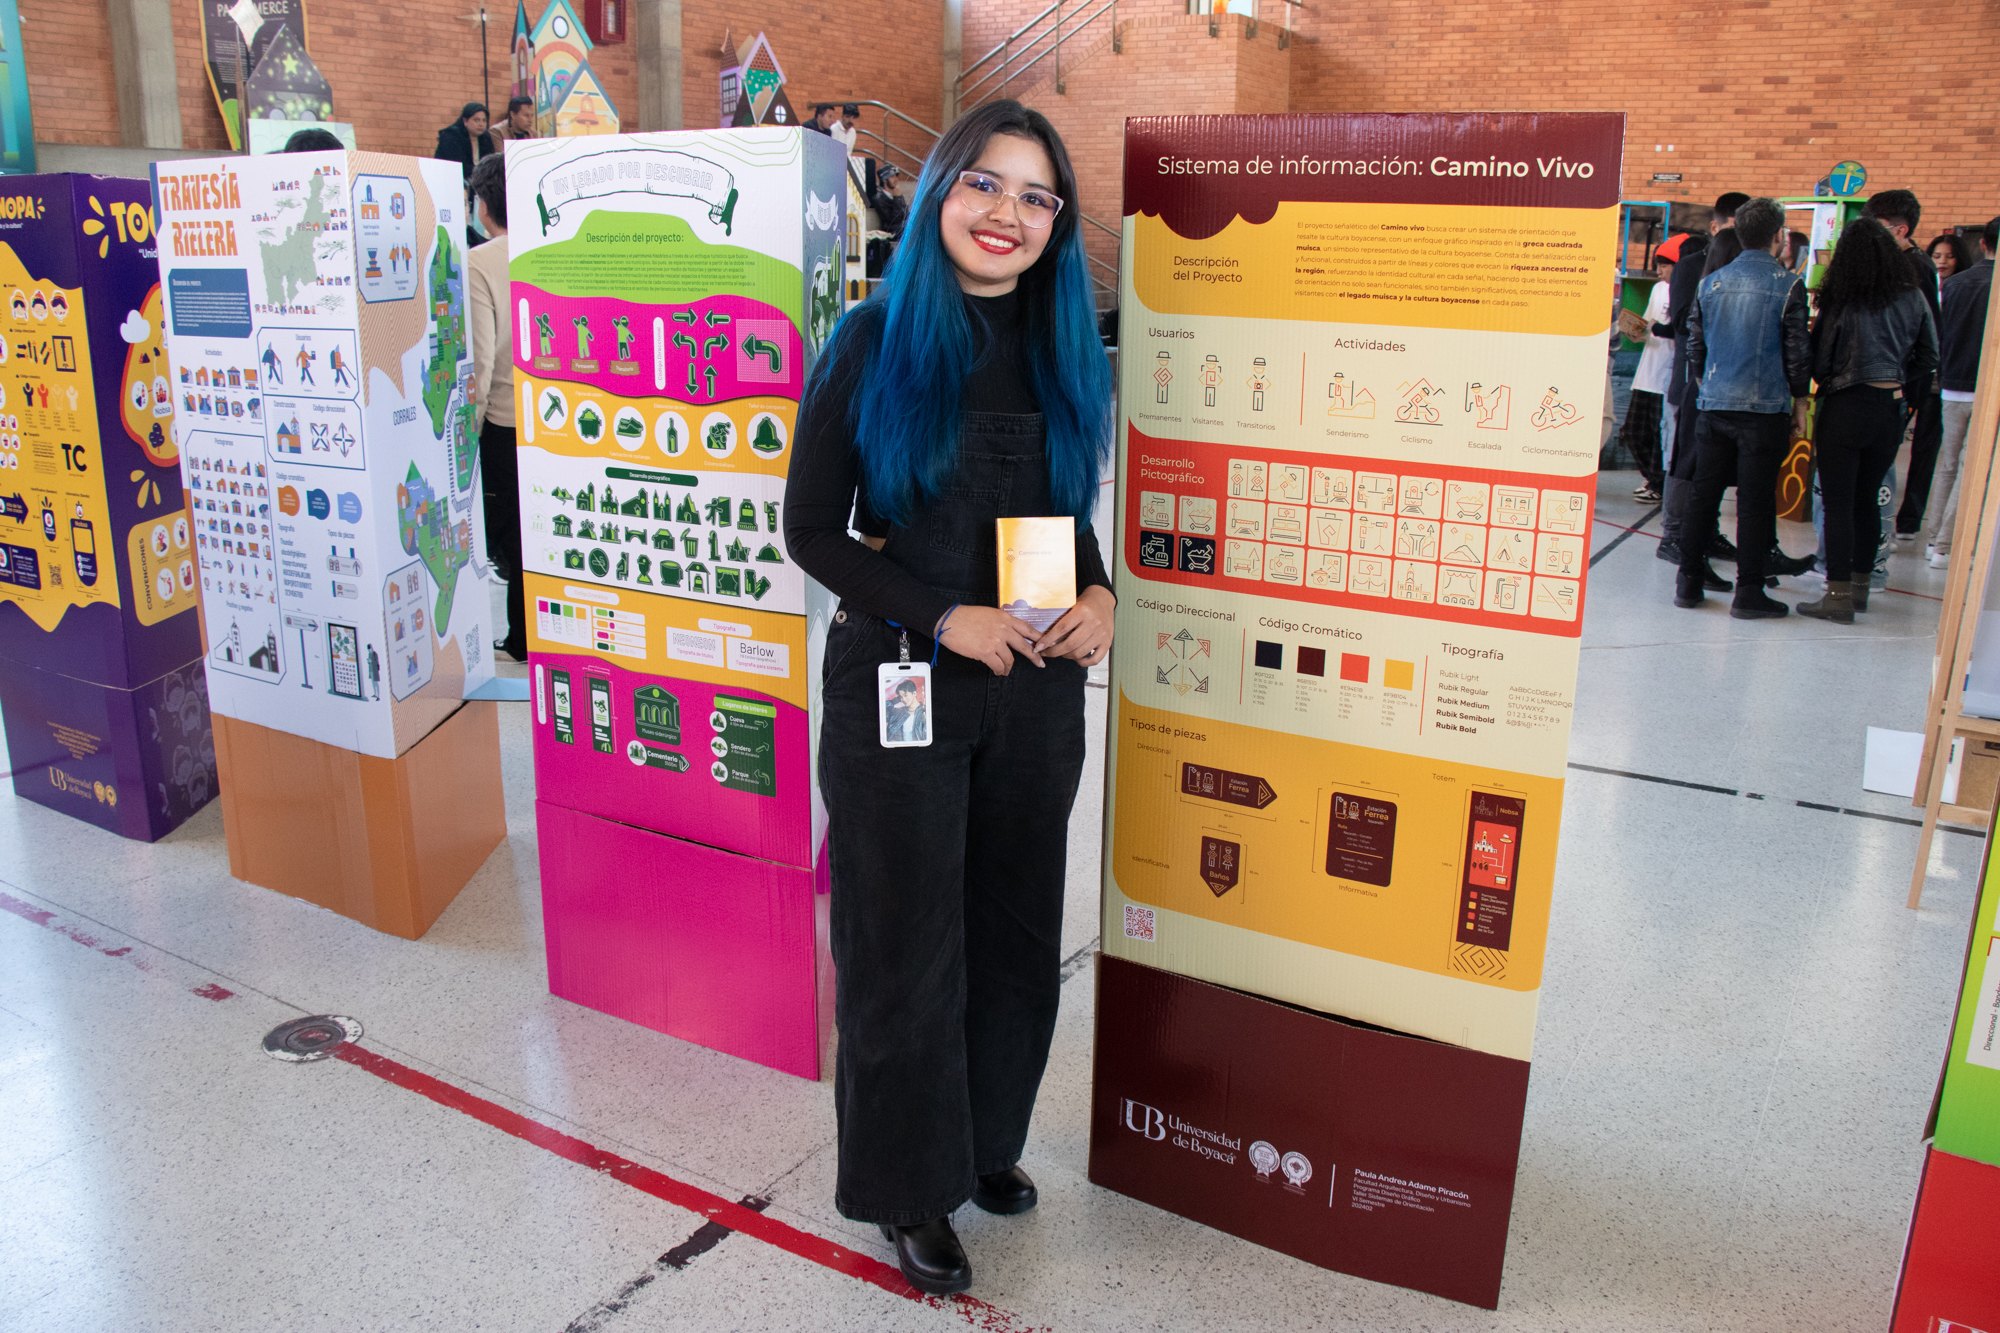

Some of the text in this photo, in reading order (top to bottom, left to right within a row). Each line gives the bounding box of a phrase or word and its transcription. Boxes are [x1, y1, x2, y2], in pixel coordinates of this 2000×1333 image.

[1158, 155, 1594, 178] Sistema de información: Camino Vivo
[553, 162, 713, 195] UN LEGADO POR DESCUBRIR
[160, 164, 241, 211] TRAVESÍA
[439, 209, 451, 223] NOBSA
[172, 220, 238, 256] RIELERA
[586, 233, 684, 244] Descripción del proyecto:
[1174, 255, 1238, 269] Descripción
[1173, 271, 1242, 283] del Proyecto
[1148, 328, 1194, 339] Usuarios
[1334, 338, 1406, 352] Actividades
[155, 406, 171, 415] Nobsa
[393, 406, 416, 426] CORRALES
[1139, 413, 1181, 423] Premanentes
[1192, 417, 1224, 426] Visitantes
[1236, 421, 1275, 430] Transitorios
[1326, 429, 1369, 439] Senderismo
[1401, 435, 1432, 445] Ciclismo
[1468, 441, 1502, 450] Escalada
[1522, 446, 1593, 458] Ciclomontañismo
[61, 443, 87, 471] TC
[1141, 455, 1194, 469] Desarrollo
[1140, 468, 1204, 484] Pictográfico
[139, 538, 152, 610] CONVENCIONES
[1136, 598, 1236, 622] Código Direccional
[1258, 616, 1362, 641] Código Cromático
[672, 632, 716, 651] NEONEON
[740, 643, 774, 657] Barlow
[1442, 642, 1504, 660] Tipografía
[1440, 670, 1479, 682] Rubik Light
[1439, 683, 1488, 696] Rubik Regular
[1437, 696, 1489, 710] Rubik Medium
[1508, 702, 1545, 713] STUVWXYZ
[730, 716, 745, 724] Cueva
[1436, 709, 1495, 724] Rubik Semibold
[1130, 718, 1206, 741] Tipos de piezas
[1436, 722, 1457, 731] Rubik
[731, 743, 751, 752] Sendero
[1137, 743, 1171, 754] Direccional
[648, 750, 678, 762] Cementerio
[49, 766, 66, 790] UB
[732, 769, 749, 778] Parque
[1432, 773, 1456, 783] Totem
[1229, 784, 1249, 793] Ferrea
[1364, 810, 1389, 820] Ferrea
[1500, 808, 1519, 816] Nobsa
[1132, 855, 1170, 869] Identificativa
[1210, 871, 1229, 881] Baños
[1339, 884, 1377, 897] Informativa
[1983, 1014, 1998, 1051] Direccional
[1126, 1099, 1166, 1141] UB
[1168, 1114, 1241, 1150] Universidad
[1173, 1134, 1189, 1148] de
[1355, 1168, 1469, 1199] Paula Andrea Adame Piracón
[1353, 1184, 1420, 1203] Programa Diseño Gráfico
[1354, 1177, 1377, 1186] Facultad
[1379, 1182, 1414, 1195] Arquitectura,
[1416, 1191, 1434, 1200] Diseño
[1440, 1196, 1471, 1207] Urbanismo
[1352, 1202, 1373, 1211] 202402
[1353, 1190, 1367, 1198] Taller
[1368, 1193, 1393, 1203] Sistemas
[1403, 1201, 1434, 1212] Orientación
[1359, 1197, 1385, 1208] Semestre
